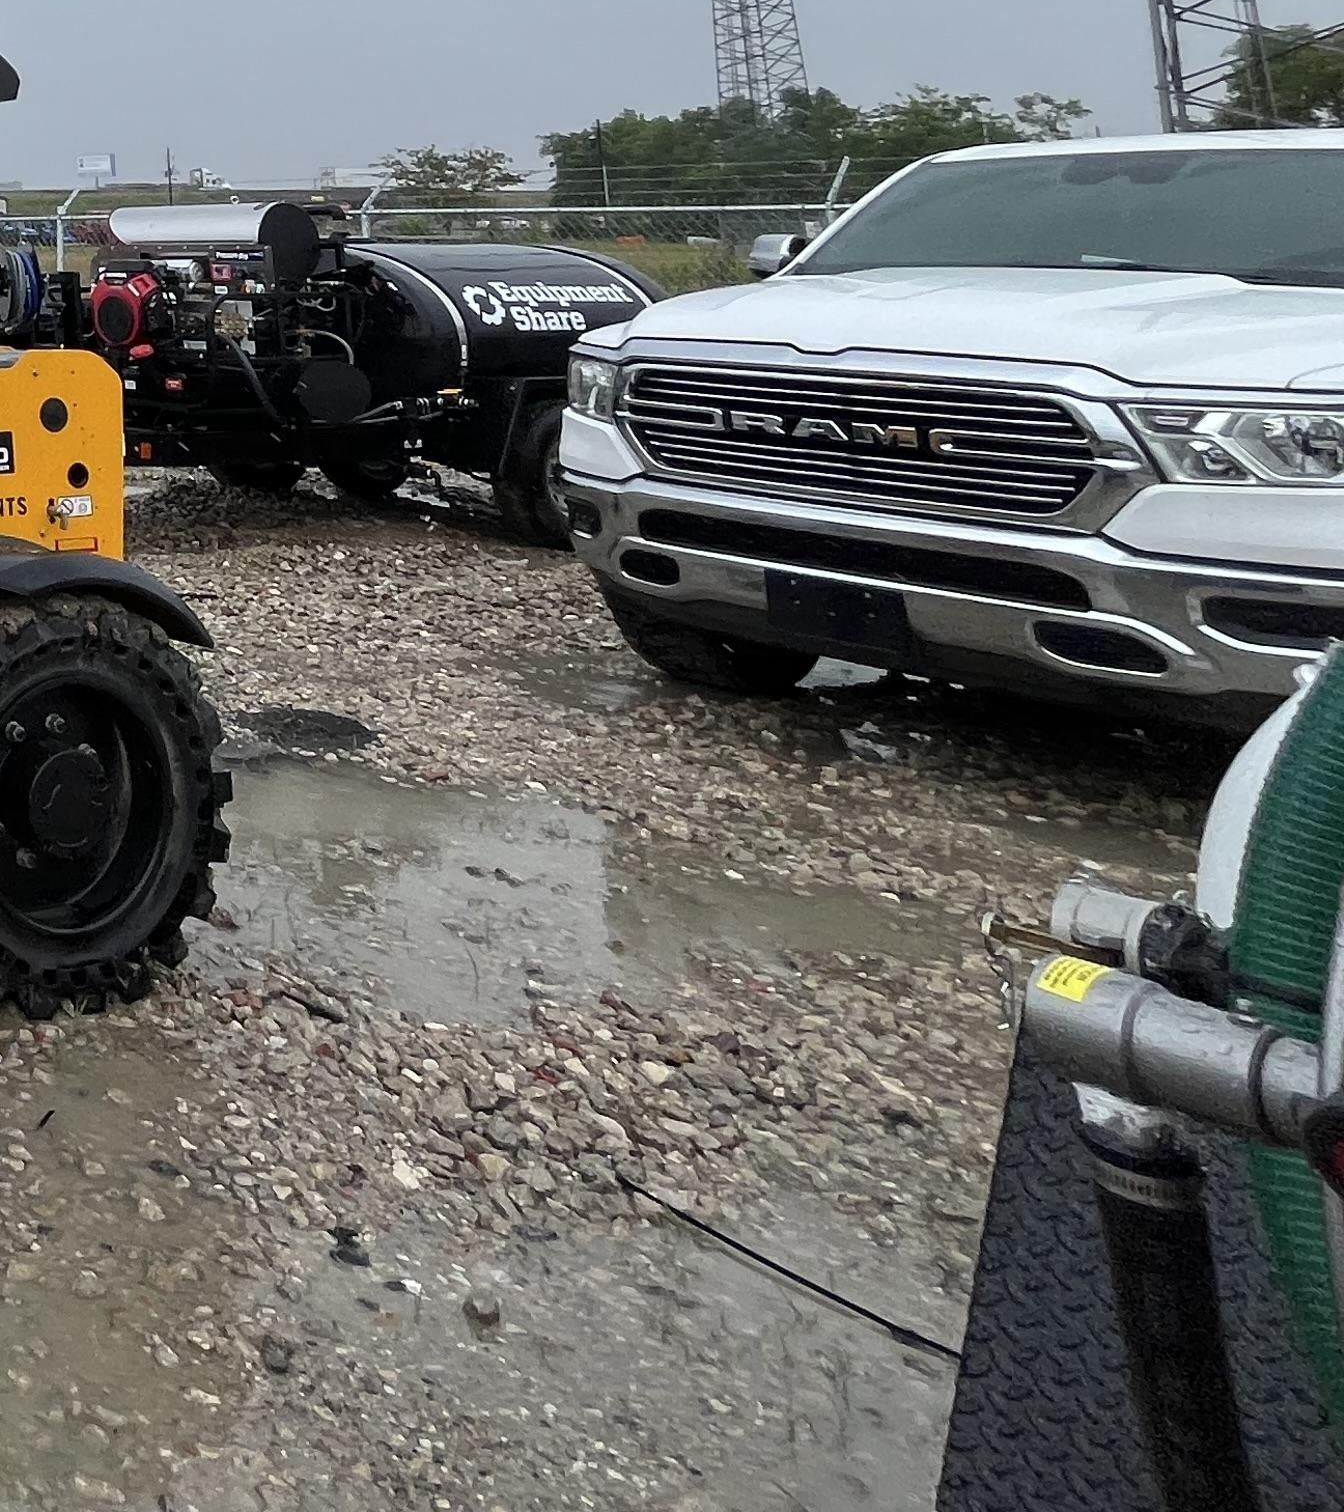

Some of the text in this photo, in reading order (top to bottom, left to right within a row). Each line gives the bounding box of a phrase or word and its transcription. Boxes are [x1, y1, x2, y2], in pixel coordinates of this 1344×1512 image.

[488, 281, 633, 307] Equipment
[510, 306, 587, 331] Share
[729, 410, 918, 449] RAM
